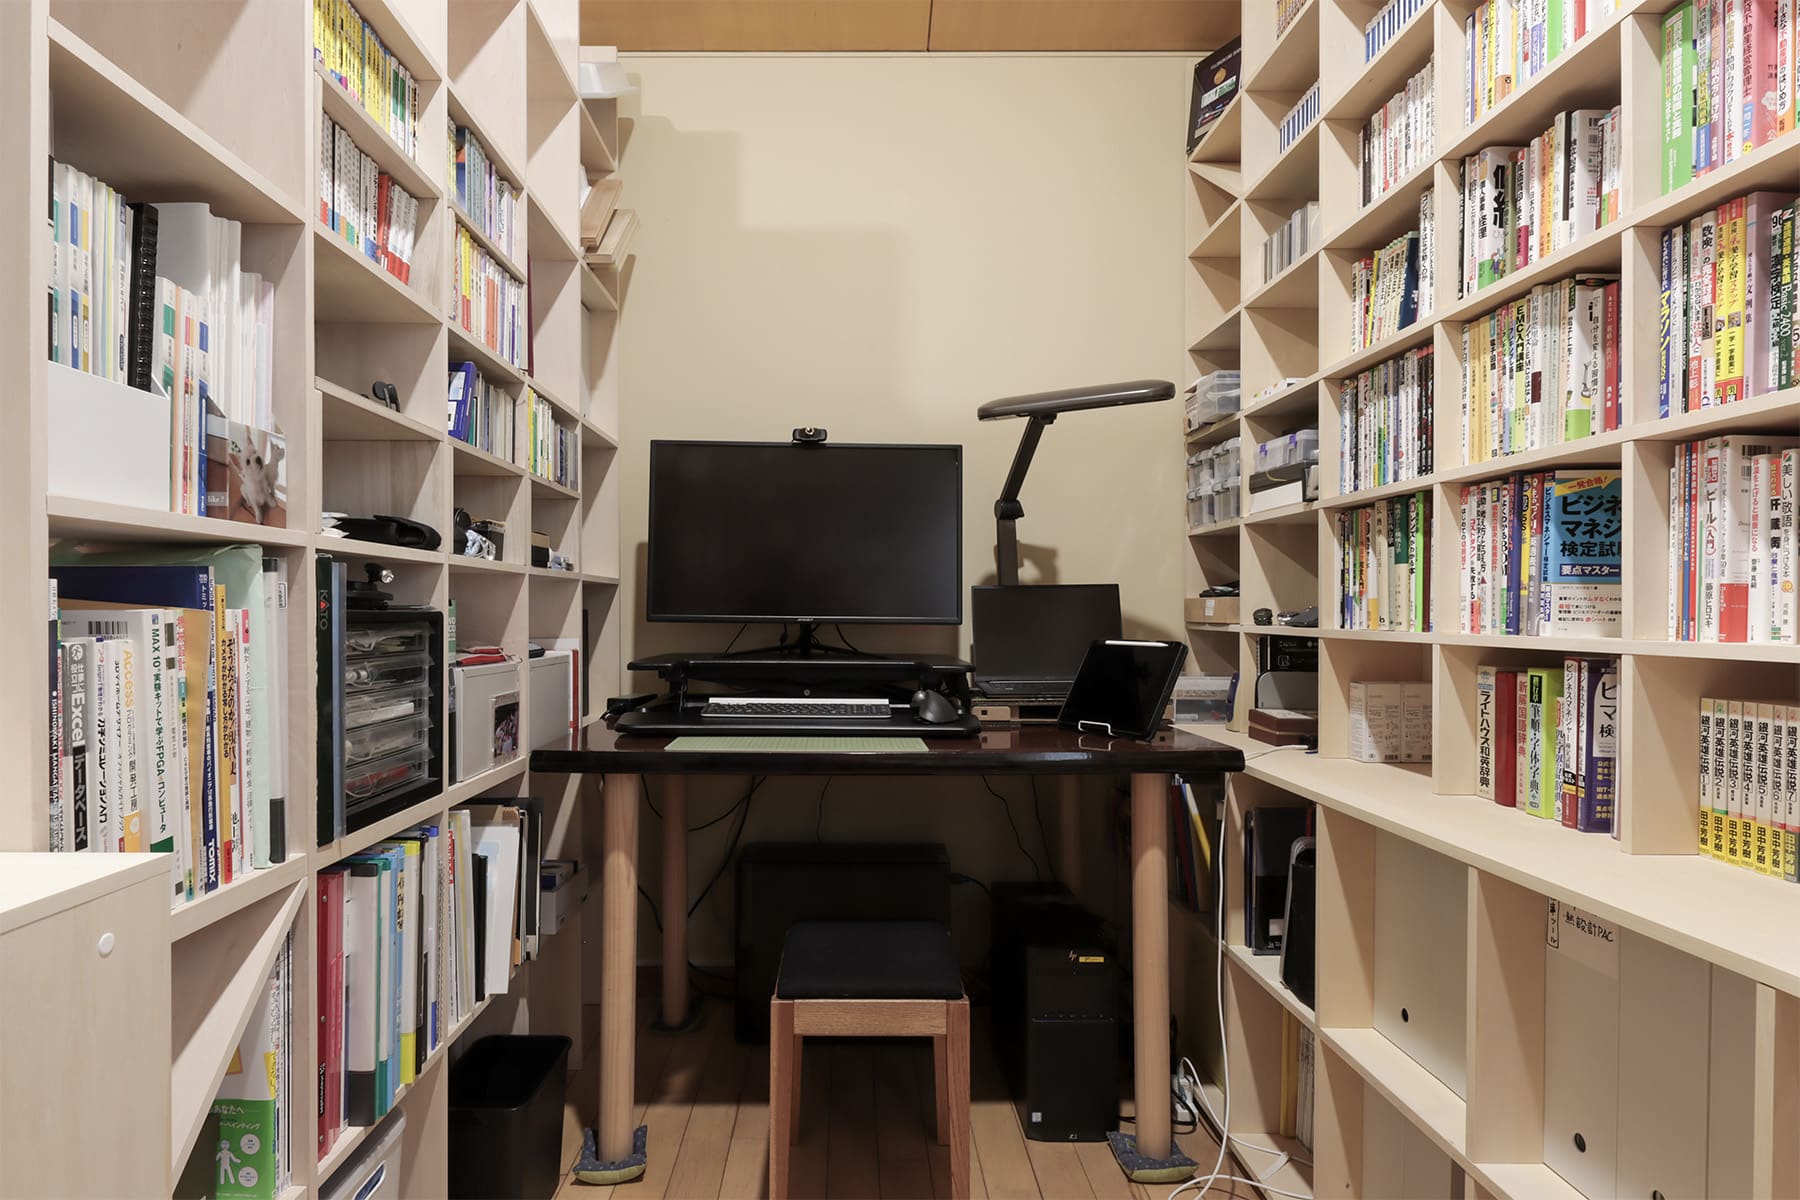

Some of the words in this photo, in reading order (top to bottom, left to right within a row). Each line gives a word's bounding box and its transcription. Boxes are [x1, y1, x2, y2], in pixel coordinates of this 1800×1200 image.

[1781, 284, 1792, 312] Basic
[1780, 313, 1791, 336] 2400
[1567, 476, 1609, 492] 一発合格!
[1560, 564, 1620, 577] 要点マスター
[152, 628, 160, 654] MAX
[71, 692, 86, 745] Excel
[1480, 690, 1491, 789] ライトハウス和英辞典
[1530, 703, 1541, 794] 筆順・字体字典
[75, 753, 87, 845] データベース
[1700, 810, 1708, 847] 田中芳樹
[1714, 815, 1723, 852] 田中芳樹
[1728, 819, 1738, 857] 田中芳樹
[1742, 821, 1751, 859] 田中芳樹
[1756, 826, 1766, 865] 田中芳樹
[208, 838, 217, 883] TOMIX
[1771, 829, 1781, 869] 田中芳樹
